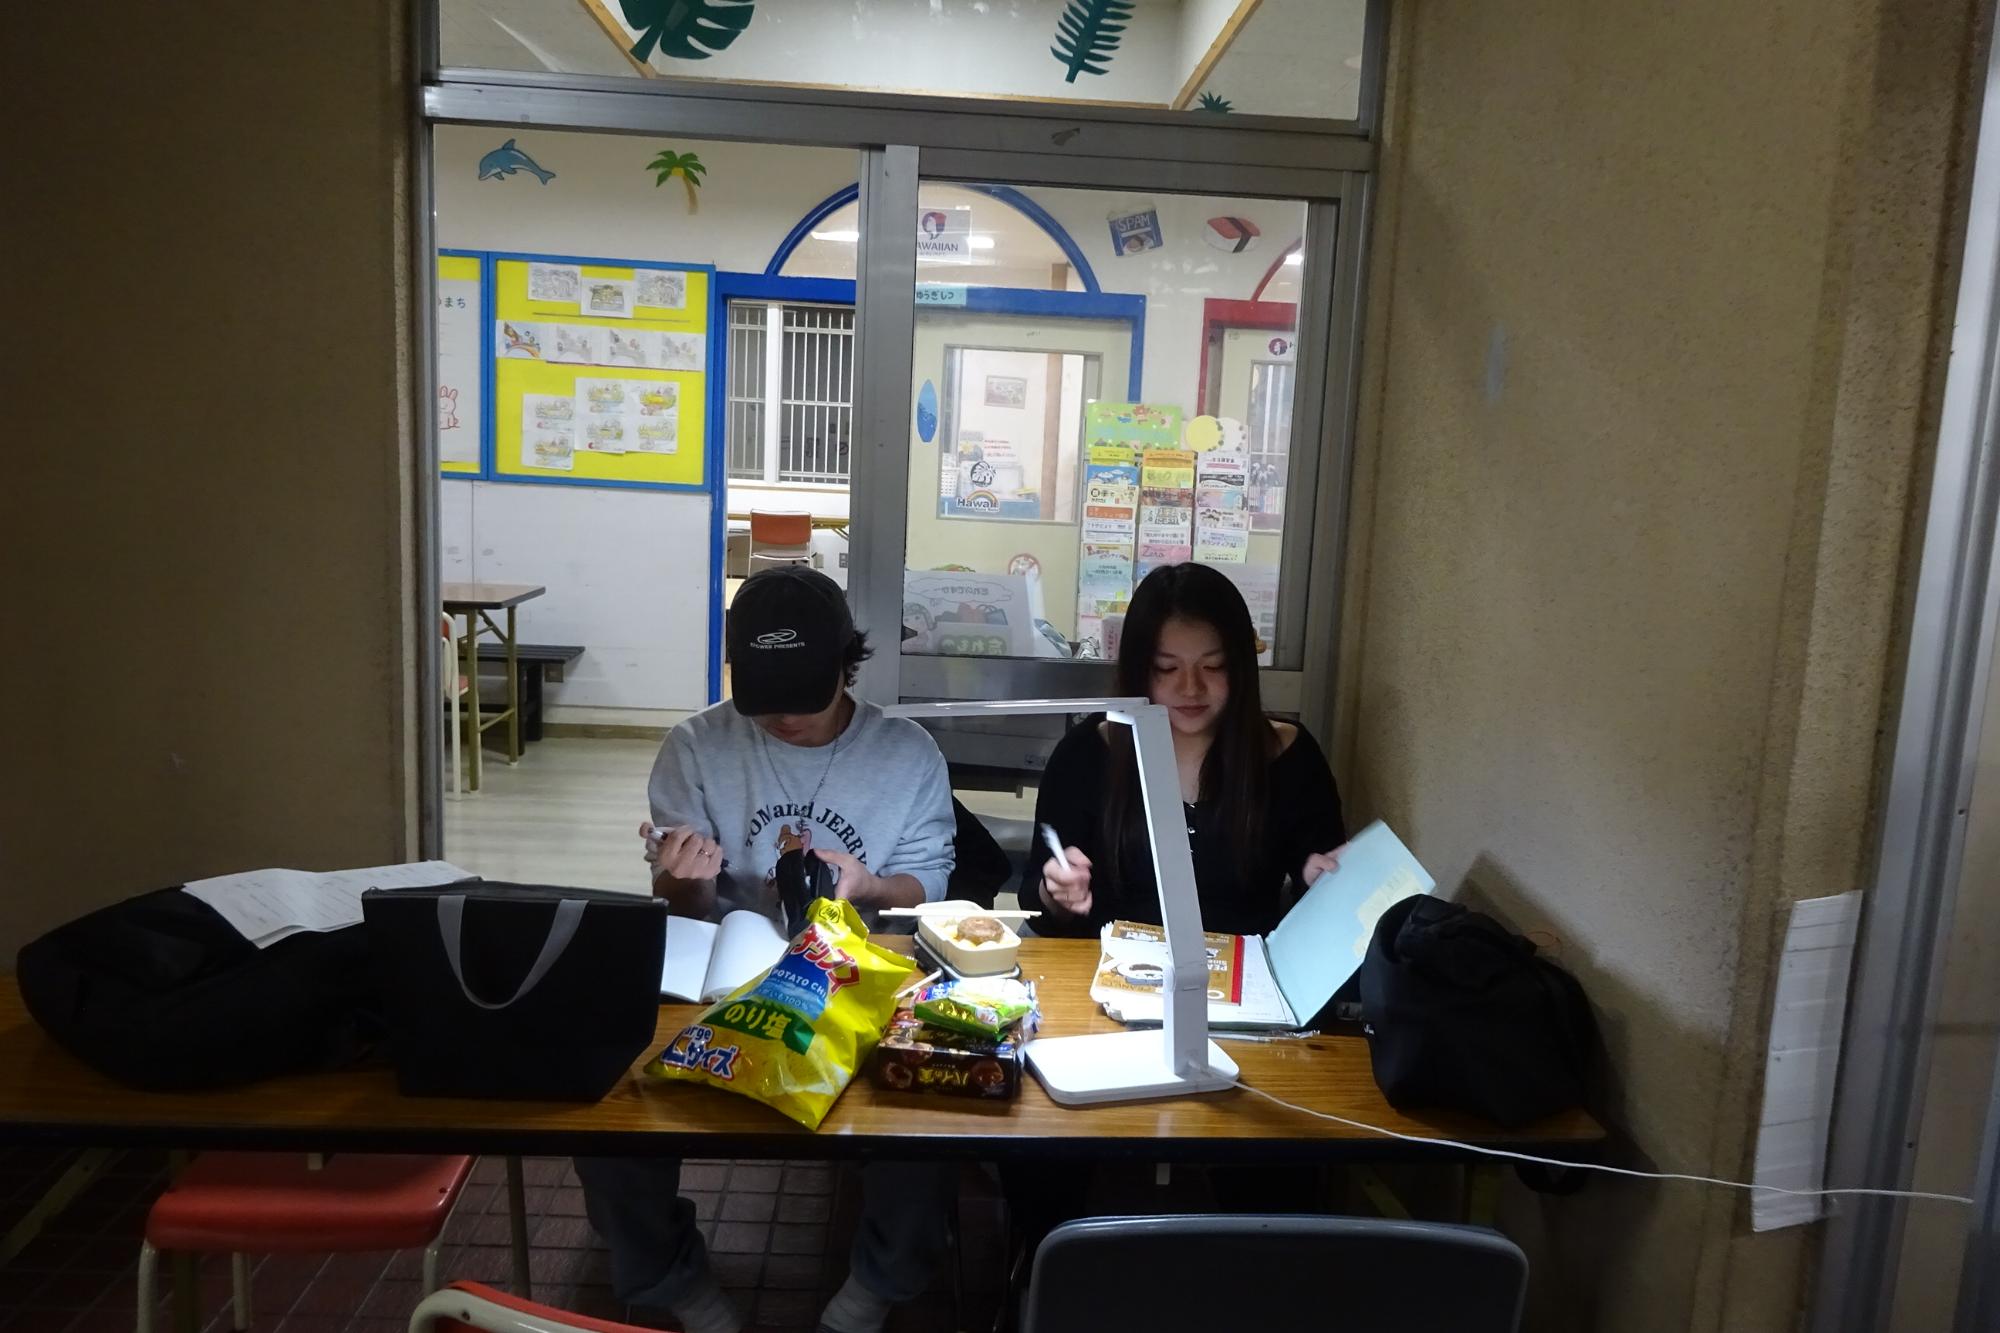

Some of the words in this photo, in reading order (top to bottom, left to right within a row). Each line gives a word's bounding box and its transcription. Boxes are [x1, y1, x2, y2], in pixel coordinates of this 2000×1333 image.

[1117, 214, 1151, 232] SPAM
[957, 497, 999, 508] Hawaii
[724, 1004, 793, 1040] のり塩
